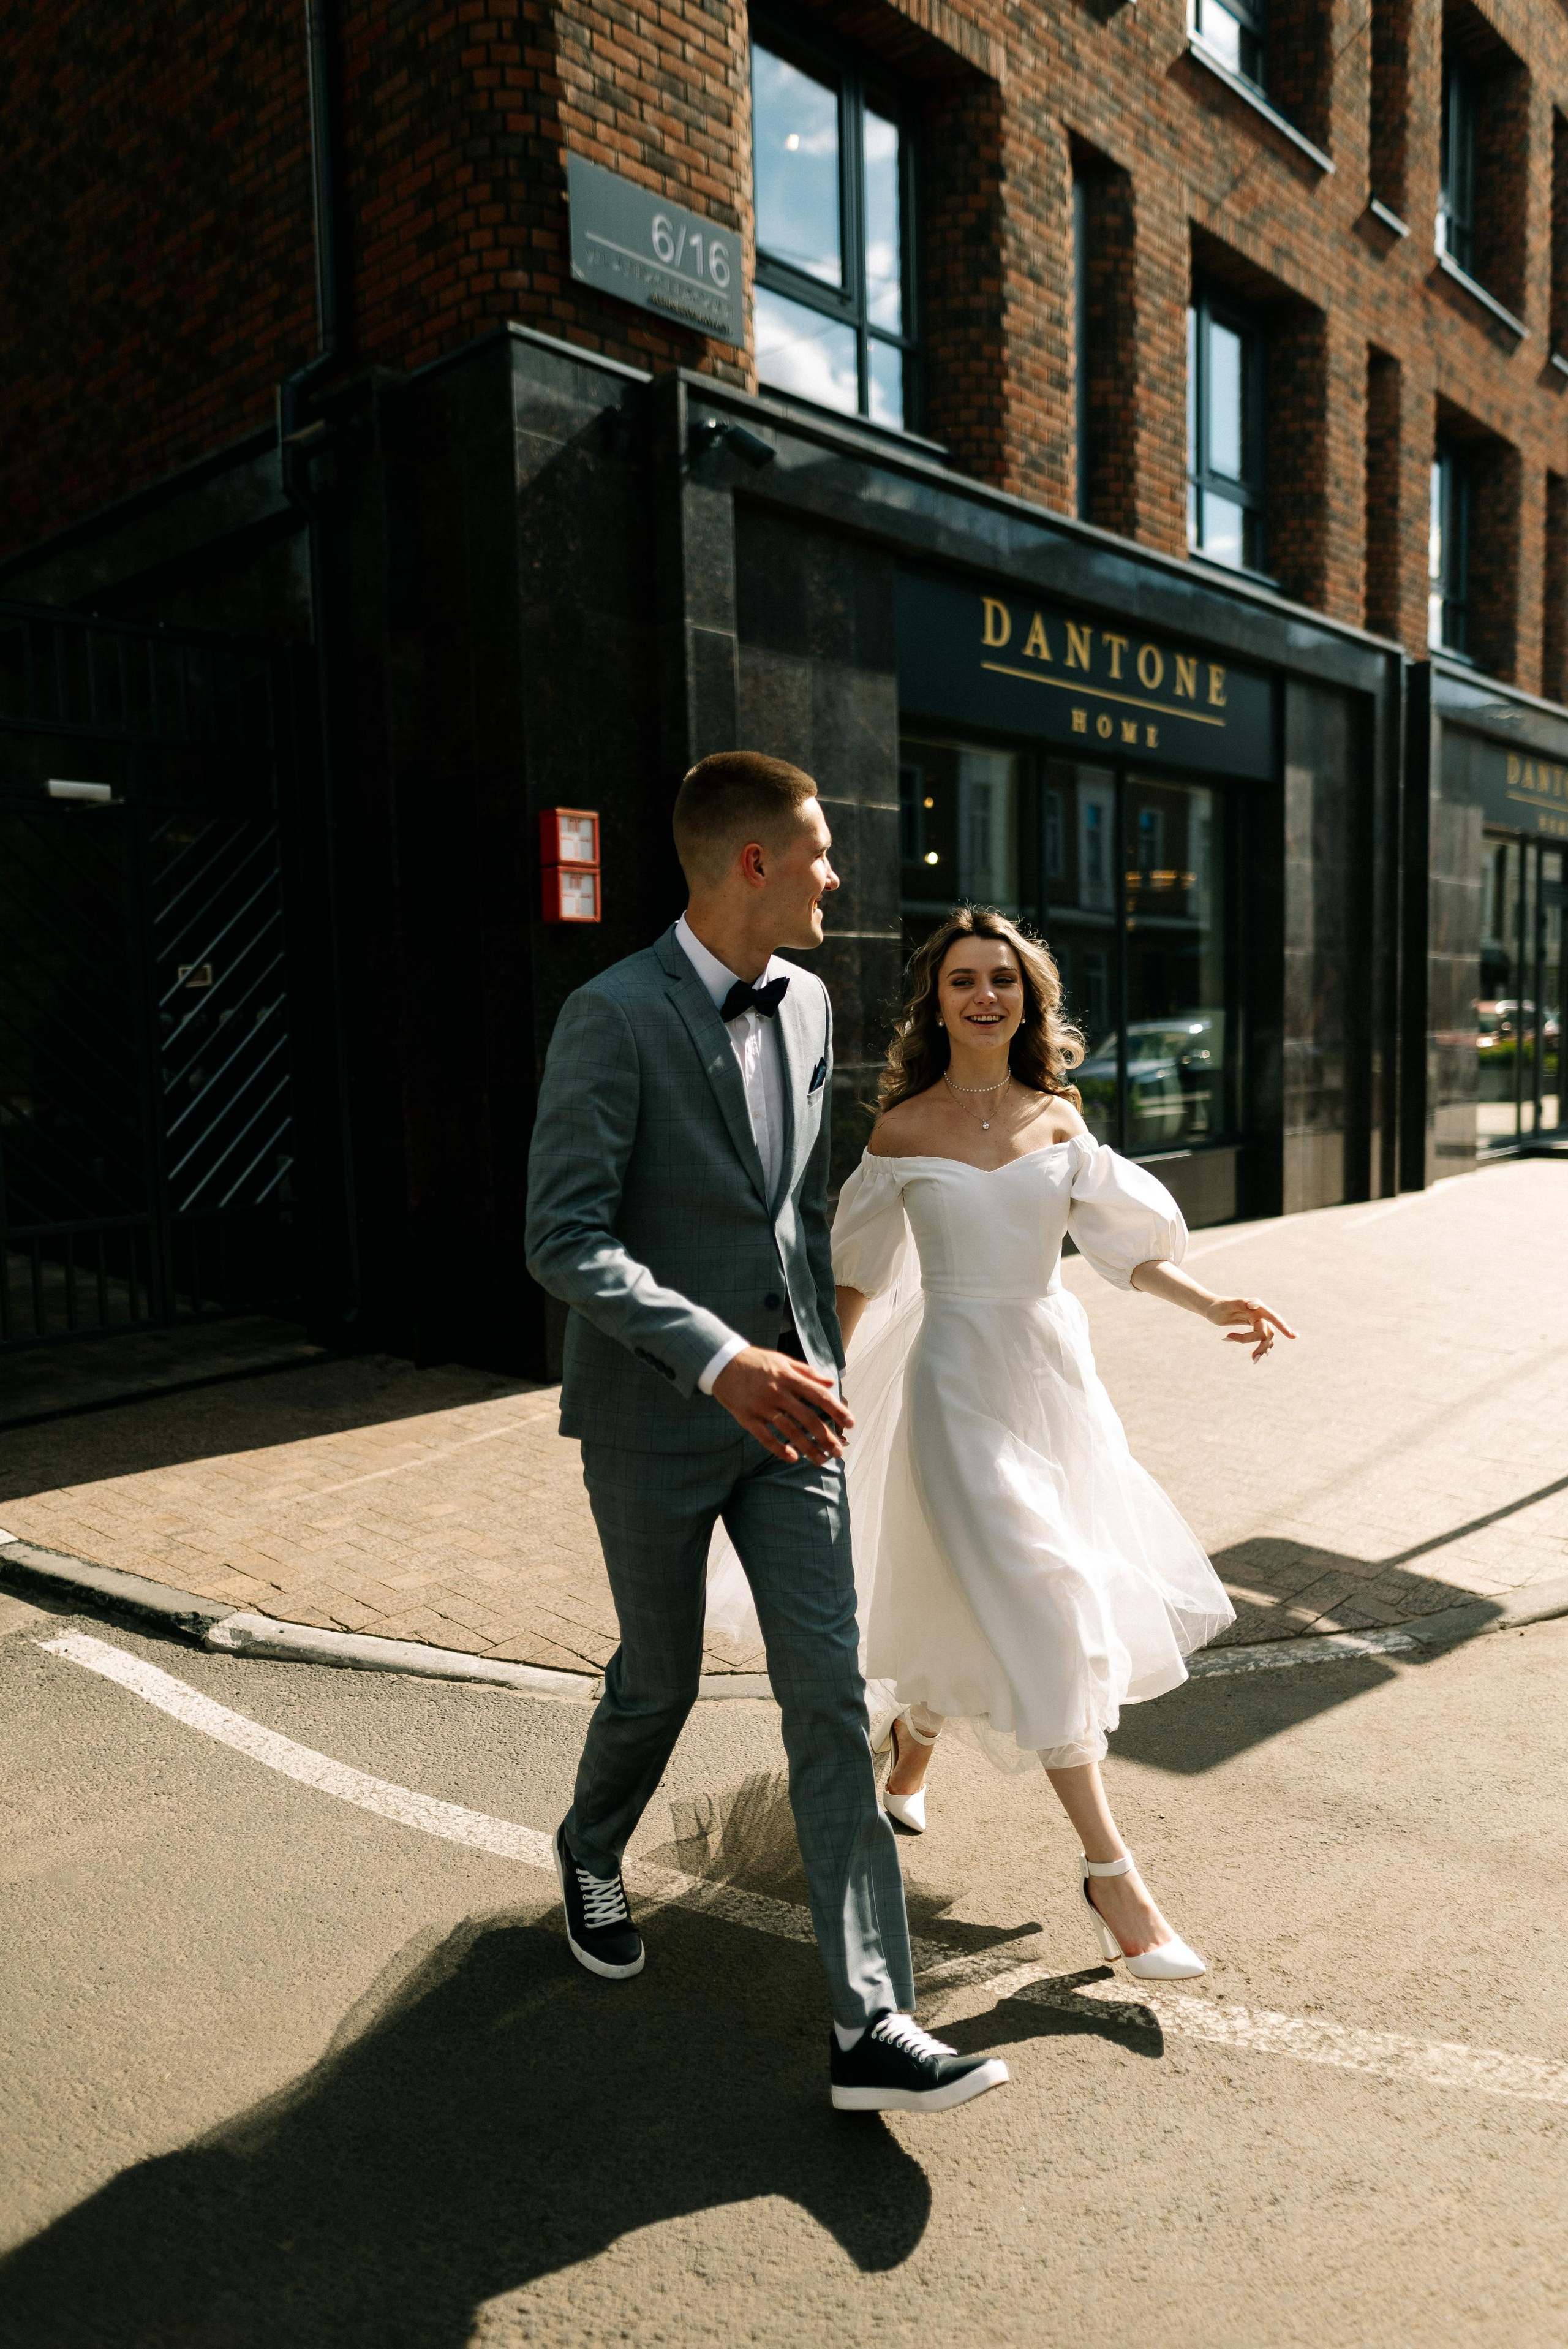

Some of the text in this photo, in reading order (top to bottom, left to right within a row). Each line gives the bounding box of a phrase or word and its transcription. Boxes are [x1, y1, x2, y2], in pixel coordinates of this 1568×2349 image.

[651, 214, 731, 288] 6/16
[981, 596, 1227, 708] DANTONE
[1071, 707, 1159, 749] HOME
